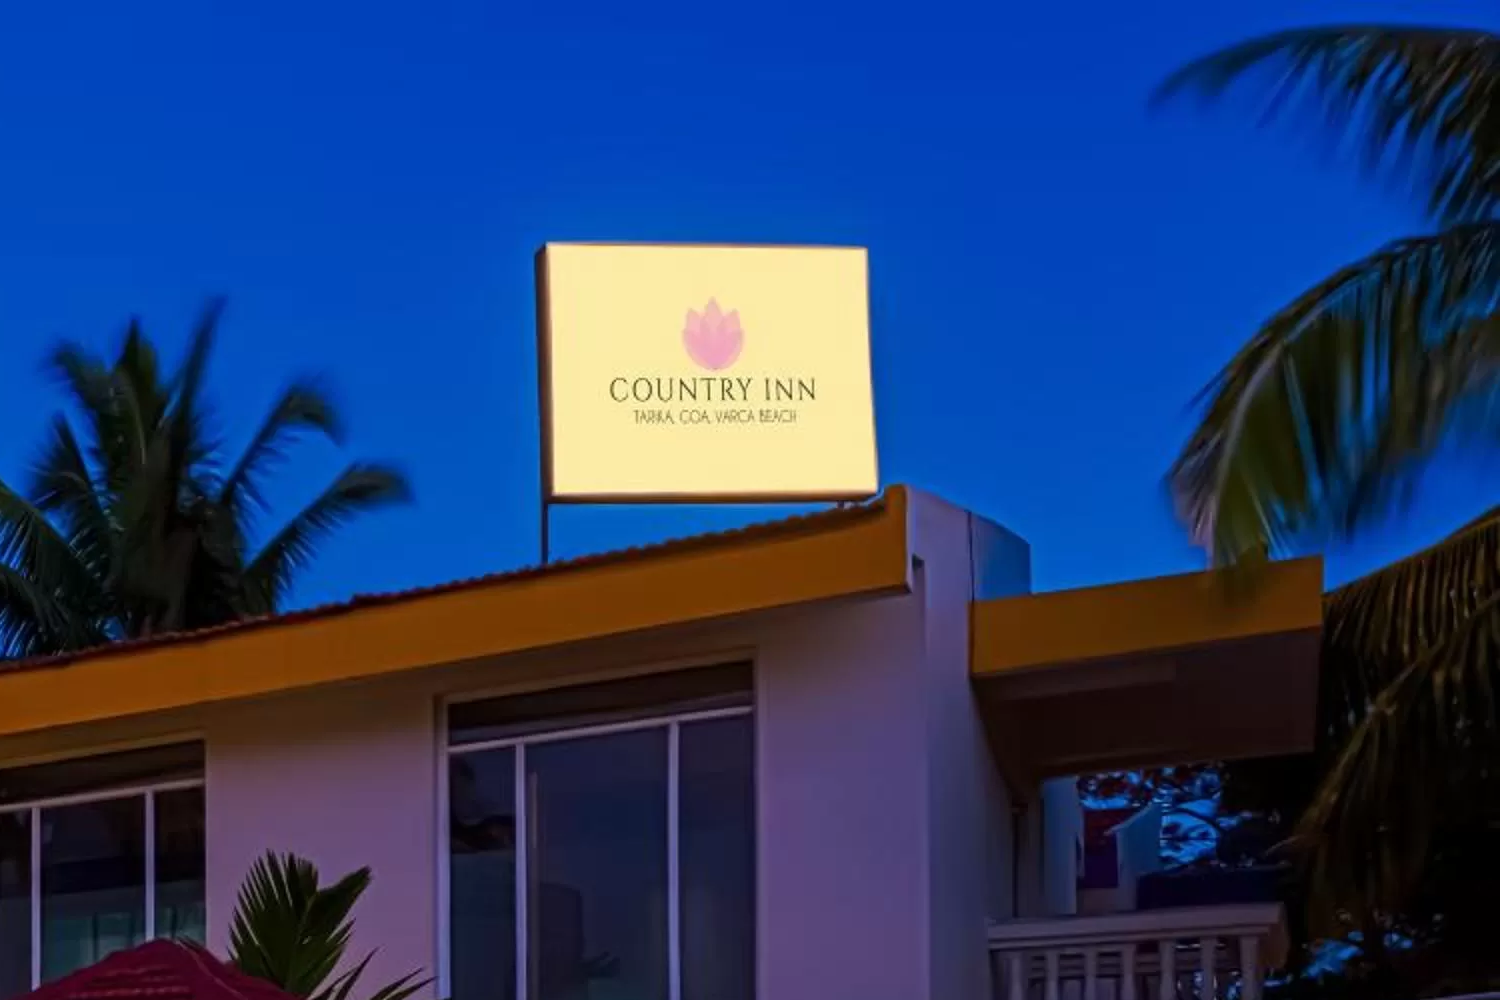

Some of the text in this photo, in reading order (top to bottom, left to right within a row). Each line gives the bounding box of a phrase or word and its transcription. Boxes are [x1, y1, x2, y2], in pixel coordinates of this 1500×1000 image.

[609, 377, 816, 403] COUNTRY INN
[759, 409, 797, 424] BEACH
